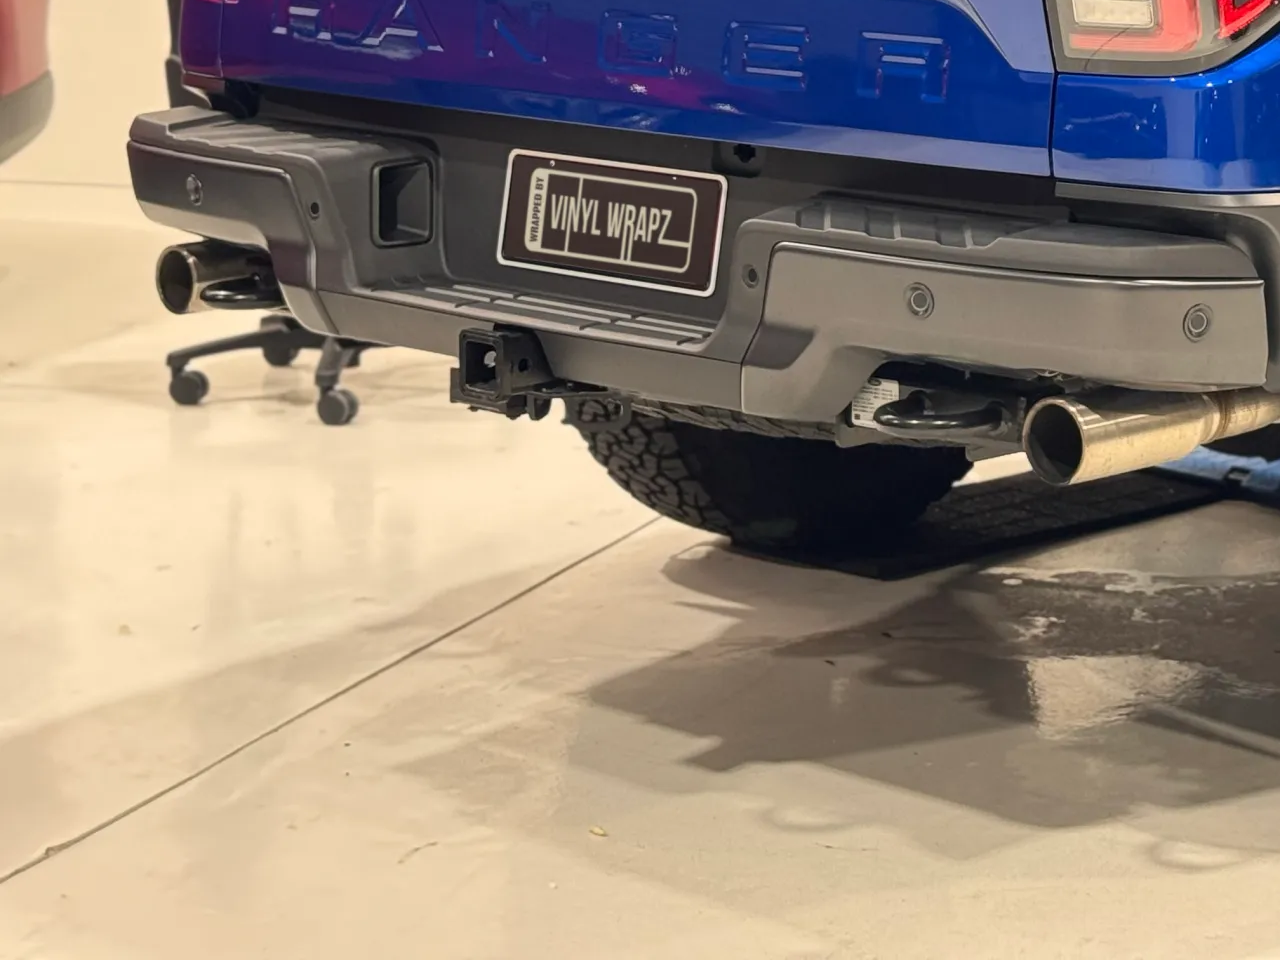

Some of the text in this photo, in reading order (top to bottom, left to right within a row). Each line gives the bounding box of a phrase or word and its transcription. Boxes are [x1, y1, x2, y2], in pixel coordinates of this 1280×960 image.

[529, 176, 545, 243] WRAPPED BY
[551, 188, 678, 251] VINYL WRAPZ
